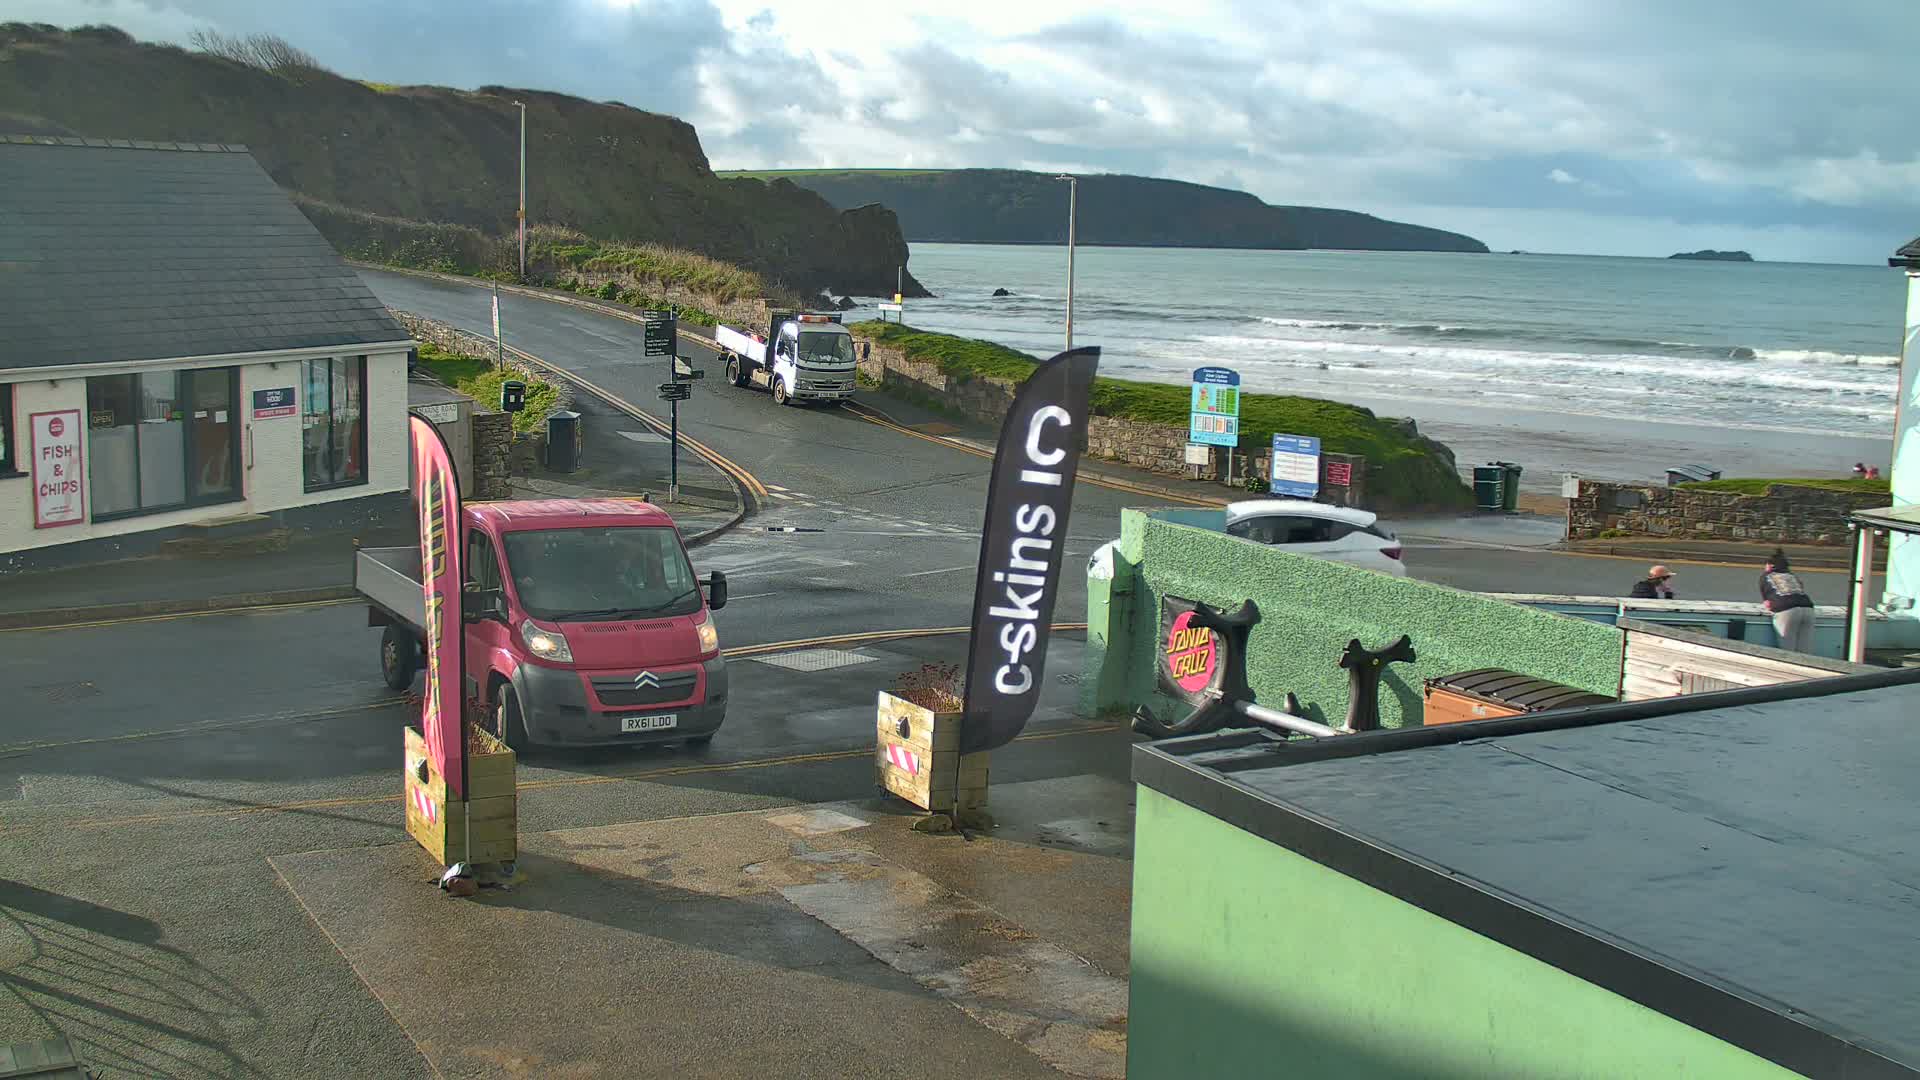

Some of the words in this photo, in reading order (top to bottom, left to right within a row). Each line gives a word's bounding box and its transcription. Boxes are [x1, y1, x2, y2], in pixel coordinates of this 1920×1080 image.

[93, 415, 113, 424] OPEN
[43, 444, 72, 460] FISH
[53, 463, 64, 477] &
[40, 480, 79, 497] CHIPS
[989, 503, 1056, 695] c-skins
[1166, 626, 1211, 654] SANTA
[1172, 649, 1209, 678] CRUZ
[652, 716, 671, 727] LDO
